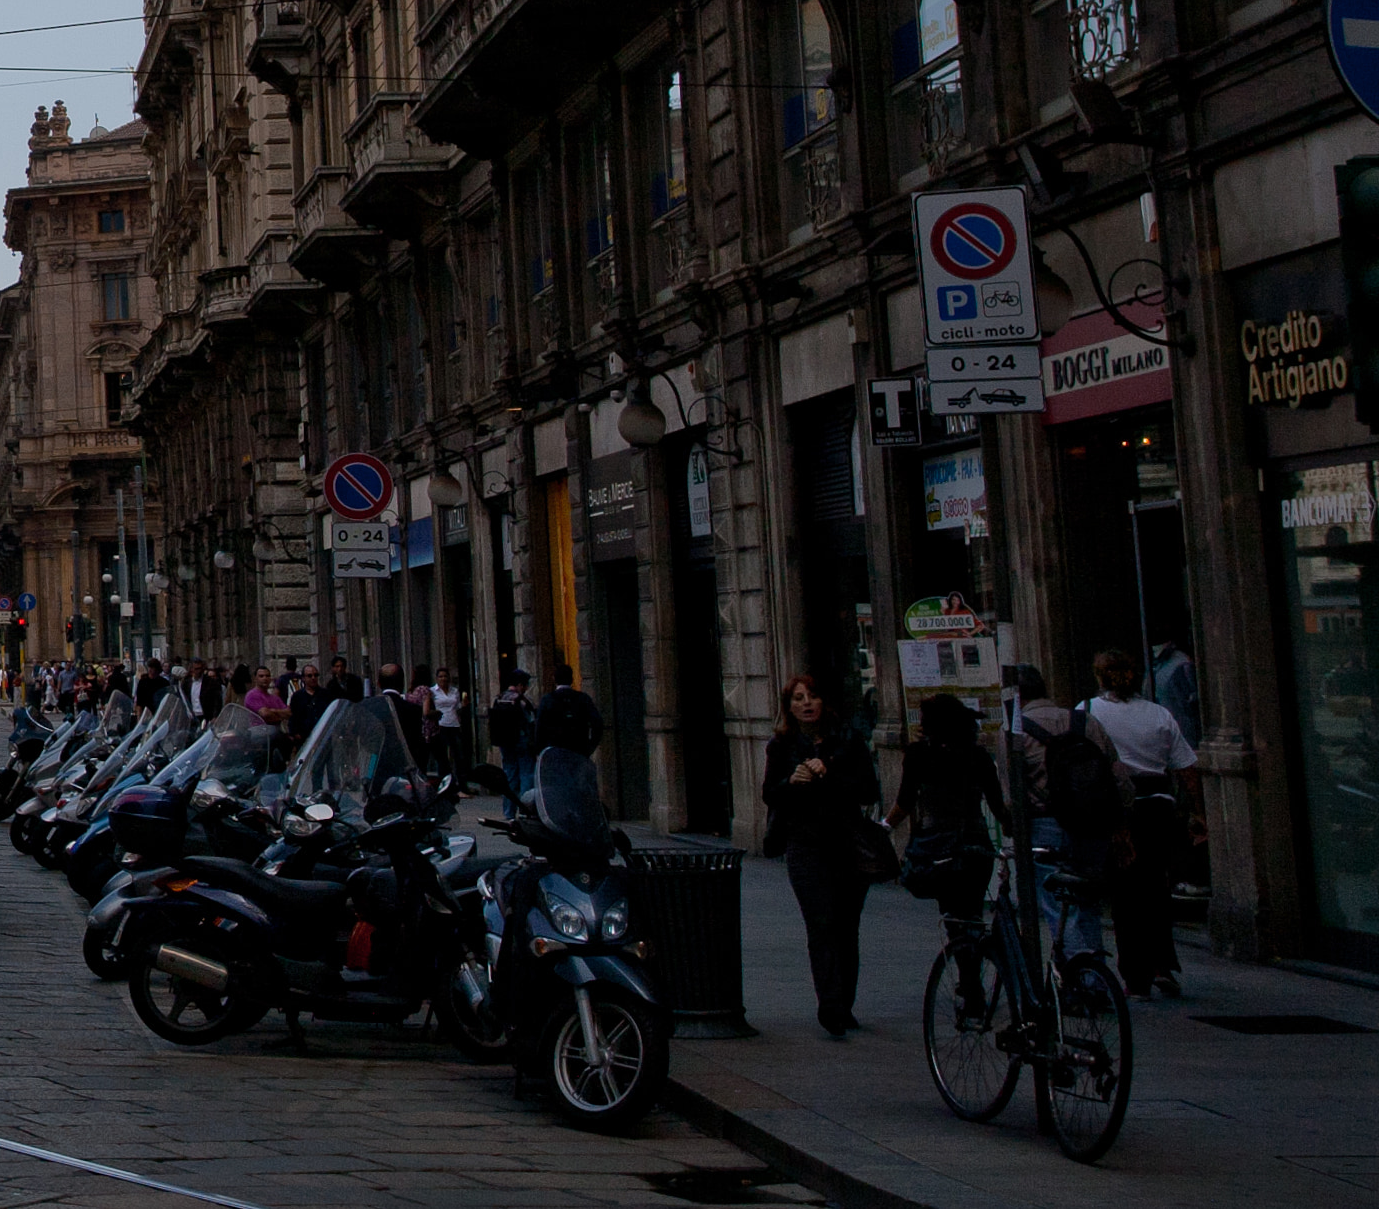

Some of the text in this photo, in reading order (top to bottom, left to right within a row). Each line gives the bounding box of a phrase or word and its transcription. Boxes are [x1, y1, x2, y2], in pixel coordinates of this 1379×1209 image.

[945, 289, 969, 317] P
[1241, 310, 1322, 362] Credito
[1052, 346, 1163, 391] BOGGI MILANO
[1248, 353, 1348, 409] Artigiano
[872, 379, 912, 428] T
[1281, 493, 1353, 529] BANCOMAT
